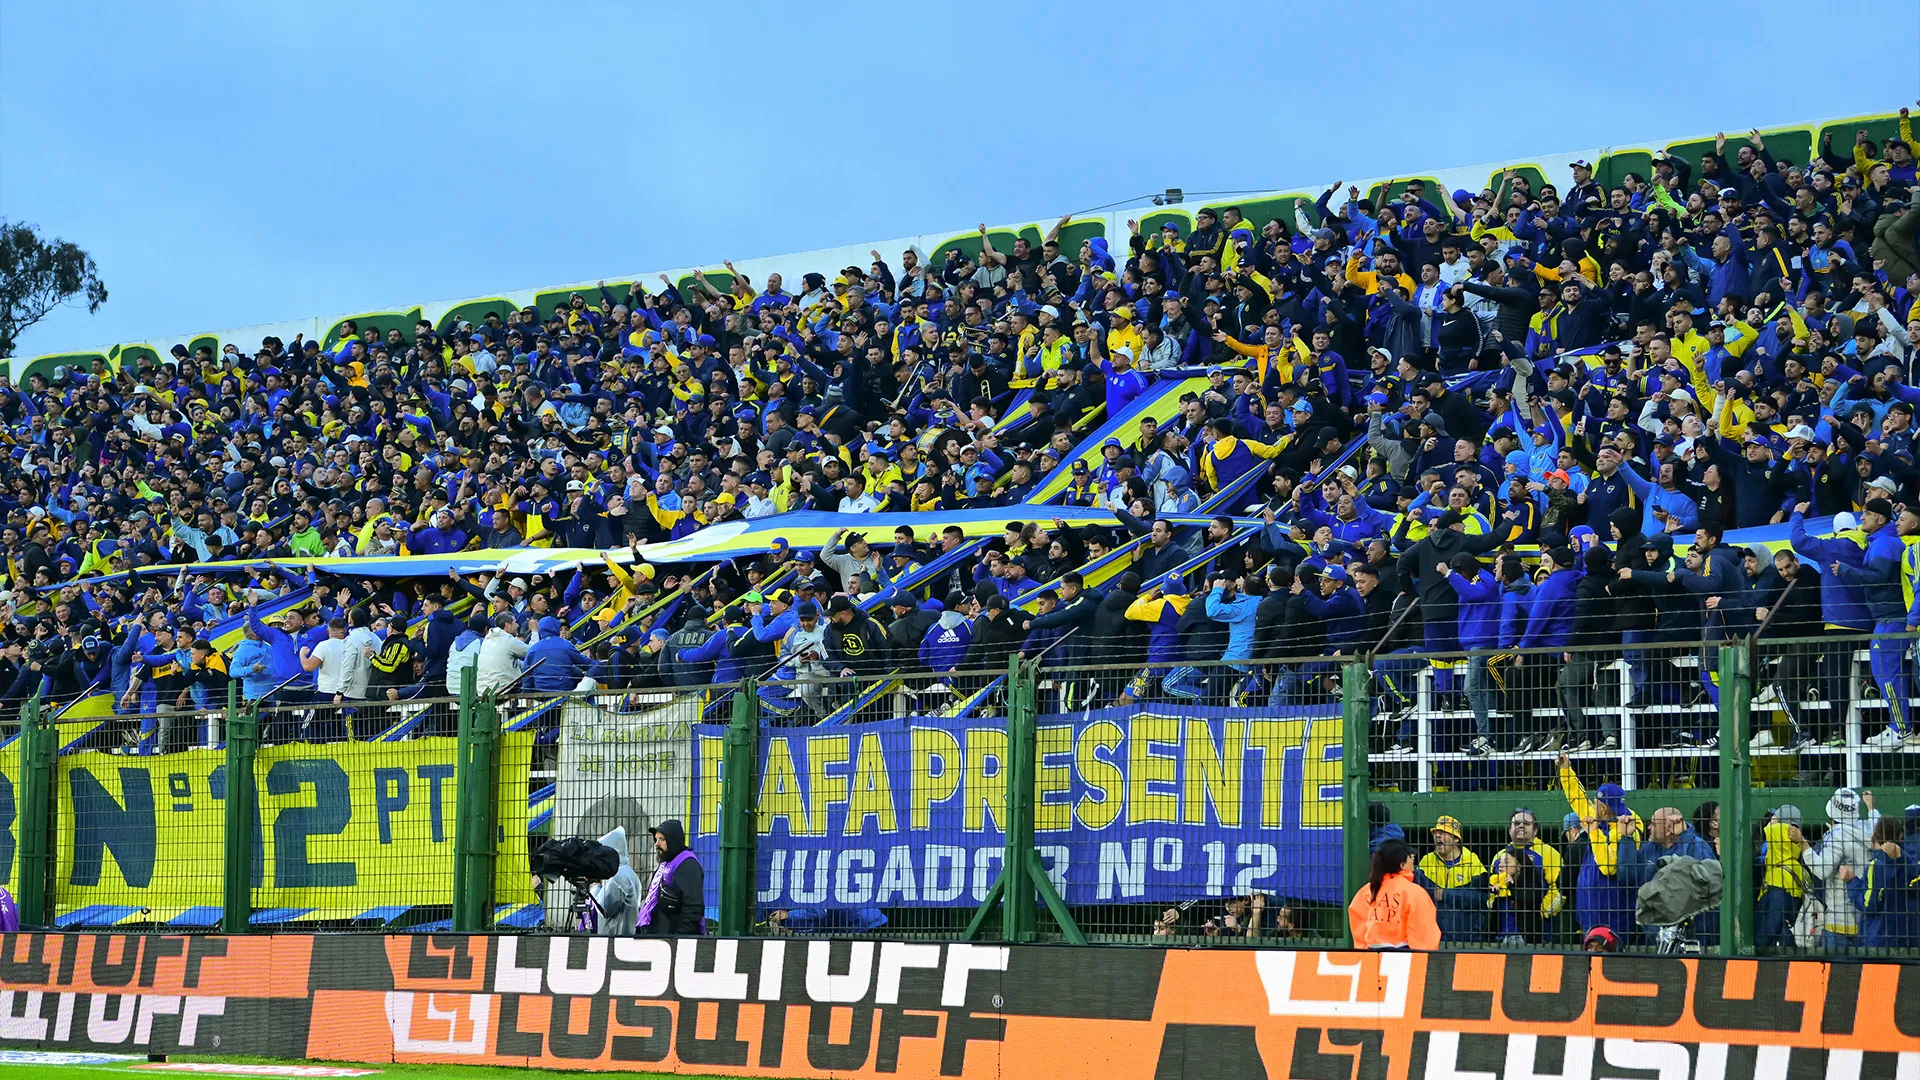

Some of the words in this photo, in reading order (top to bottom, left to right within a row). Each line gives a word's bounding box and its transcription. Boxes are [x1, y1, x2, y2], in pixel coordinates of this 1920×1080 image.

[577, 754, 605, 774] DE
[609, 751, 676, 774] JOSE
[910, 711, 1343, 834] PRESENTE
[1202, 840, 1278, 897] 12
